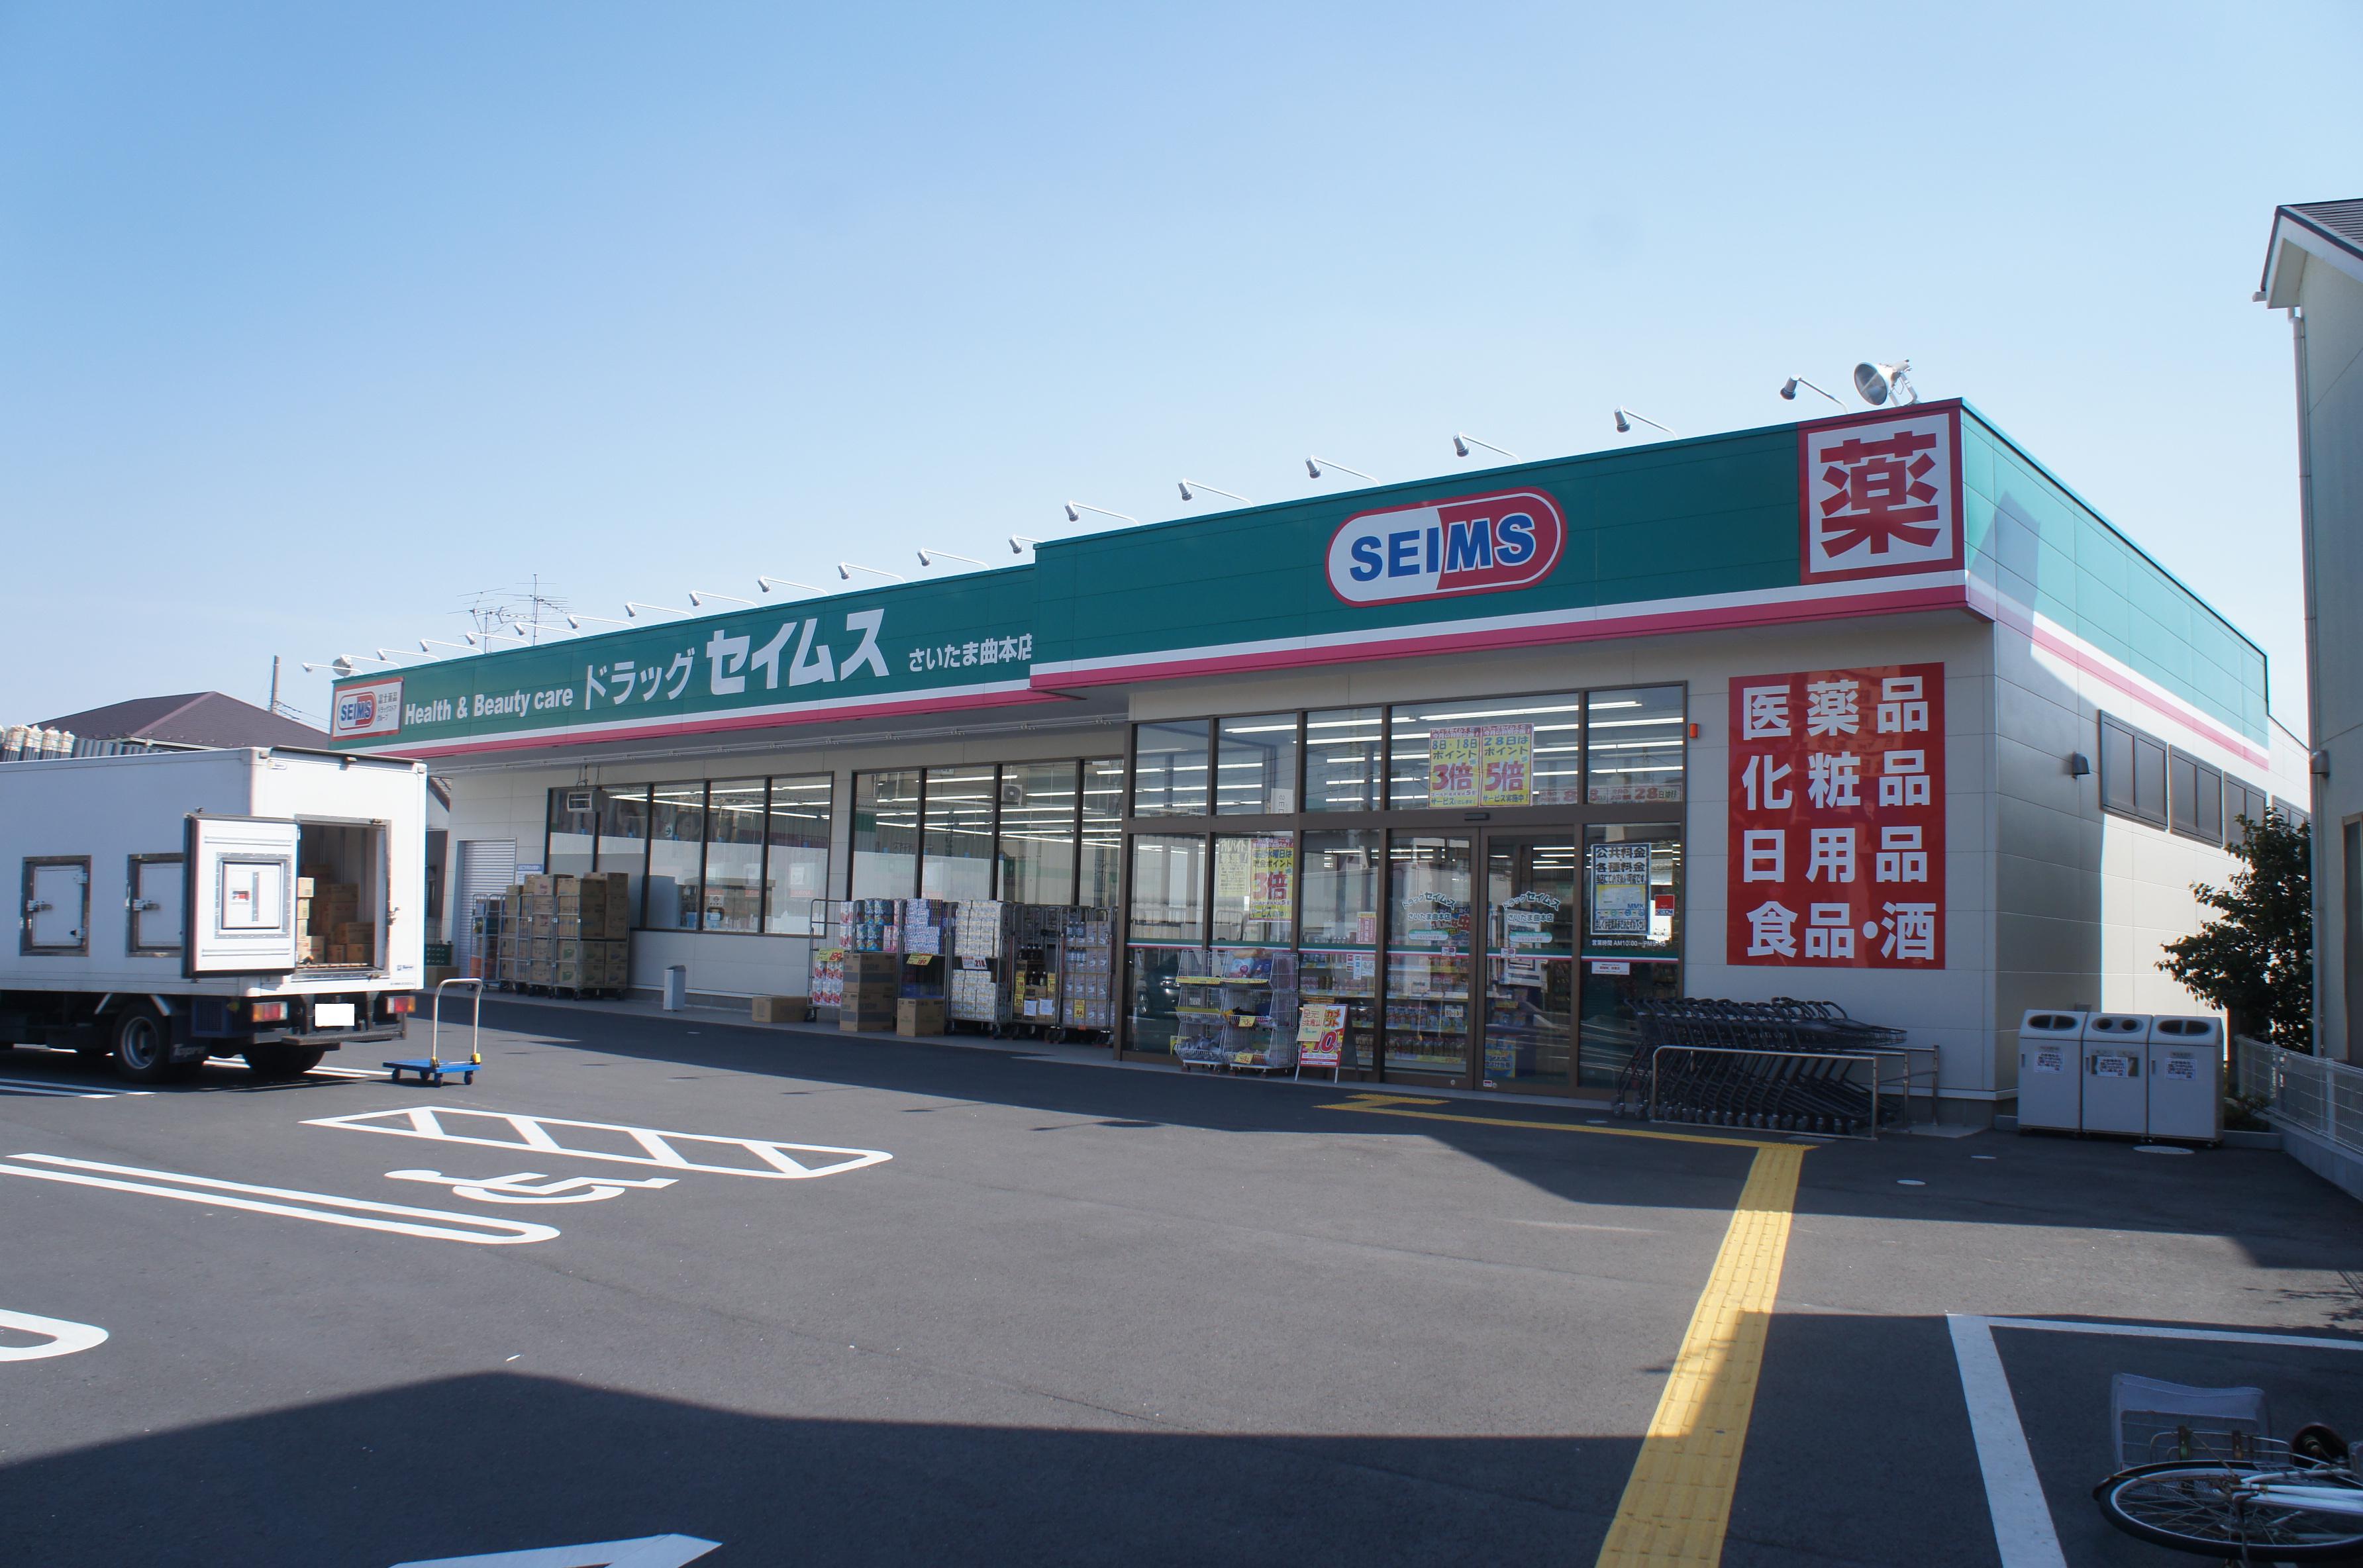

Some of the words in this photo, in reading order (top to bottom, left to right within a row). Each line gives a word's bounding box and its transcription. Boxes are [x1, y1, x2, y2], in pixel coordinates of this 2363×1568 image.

[1818, 430, 1940, 558] 薬
[1349, 513, 1538, 583] SEIMS
[585, 646, 695, 710] ドラッグ
[706, 609, 890, 696] セイムス
[909, 632, 1032, 673] さいたま曲本店
[340, 700, 372, 721] SEIMS
[405, 700, 452, 725] Health
[457, 698, 468, 718] &
[474, 689, 530, 717] Beauty
[534, 687, 574, 709] care
[1742, 675, 1929, 741] 医薬品
[1433, 750, 1478, 760] ポイント
[1483, 736, 1529, 746] 28日は
[1484, 746, 1529, 756] ポイント
[1431, 762, 1474, 791] 3倍
[1484, 760, 1525, 791] 5倍
[1742, 749, 1931, 811] 化粧品
[1595, 861, 1645, 873] 各種料金
[1596, 847, 1646, 858] 公共料金
[1742, 826, 1928, 883] 日用品
[1252, 871, 1288, 900] 3倍
[1407, 912, 1452, 922] さいたま曲本店
[1507, 912, 1554, 922] さいたま曲本店
[1746, 901, 1936, 960] 食品・酒
